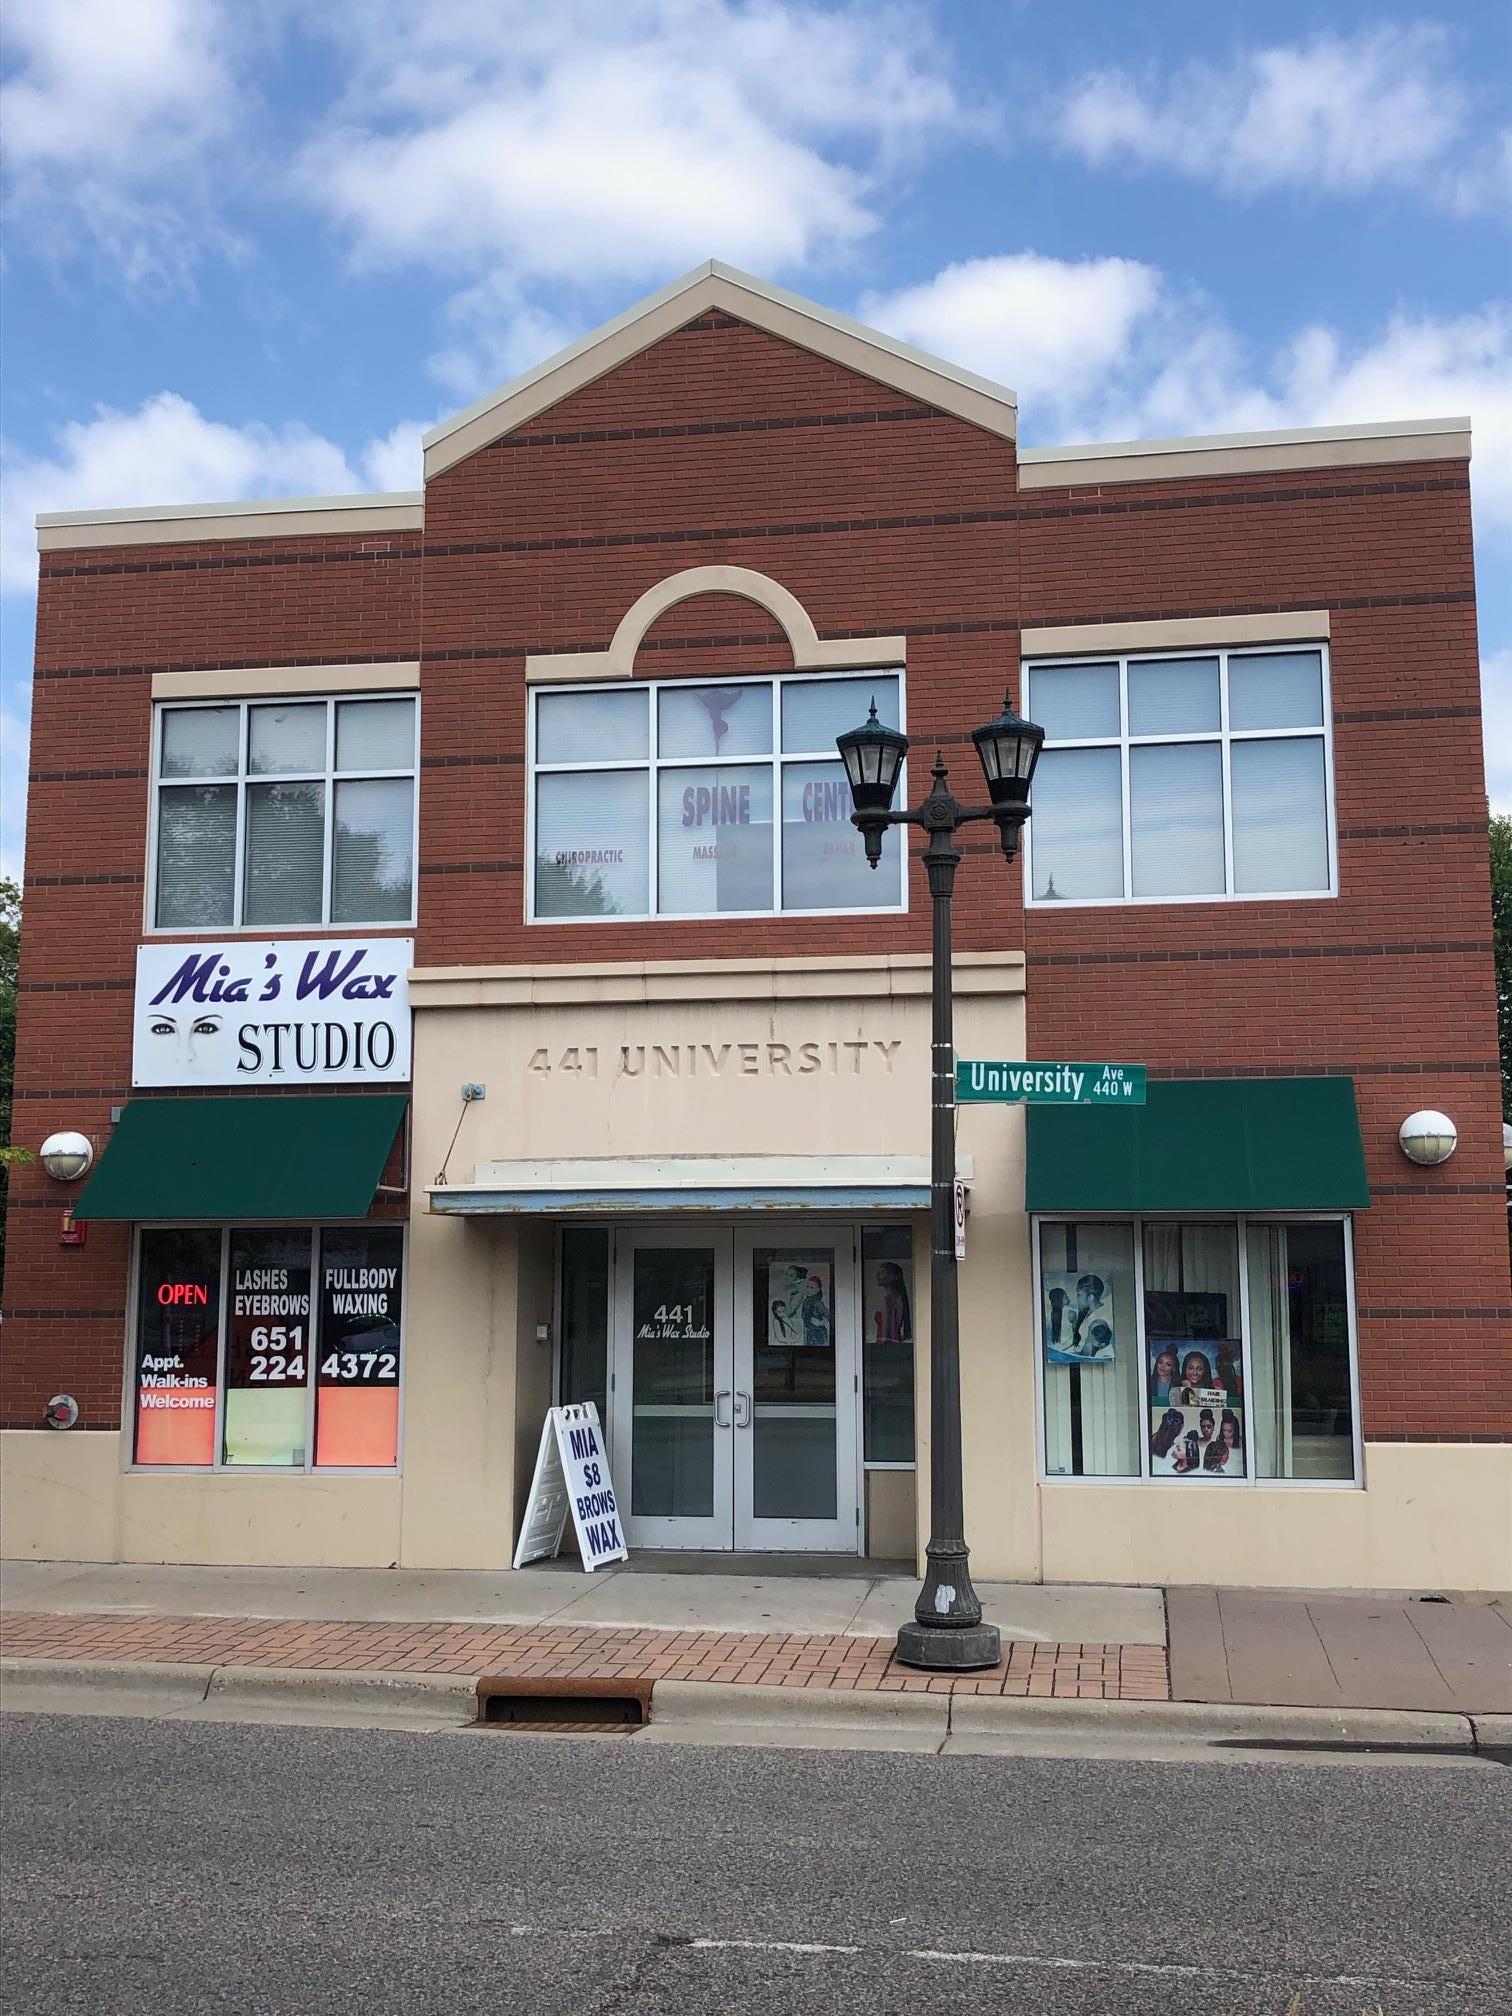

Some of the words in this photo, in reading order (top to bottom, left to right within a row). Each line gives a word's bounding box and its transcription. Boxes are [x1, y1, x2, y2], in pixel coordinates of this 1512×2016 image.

[682, 785, 750, 827] SPINE
[801, 782, 853, 822] CENT
[556, 849, 623, 864] CHIROPRACTIC
[148, 952, 285, 1006] Mia's
[296, 949, 398, 1001] Wax
[236, 1021, 398, 1074] STUDIO
[527, 1046, 599, 1081] 441
[620, 1040, 902, 1079] UNIVERSITY
[971, 1062, 1084, 1101] University
[1102, 1065, 1124, 1080] Ave
[1093, 1081, 1119, 1096] 440
[1122, 1081, 1133, 1096] W
[235, 1268, 288, 1290] LASHES
[325, 1268, 397, 1290] FULLBODY
[157, 1283, 208, 1305] OPEN
[235, 1294, 310, 1316] EYEBROWS
[332, 1293, 388, 1315] WAXING
[654, 1304, 693, 1323] 441
[250, 1326, 303, 1351] 651
[636, 1323, 661, 1338] Mia's
[662, 1323, 680, 1338] Wax
[681, 1323, 711, 1338] Studio
[141, 1354, 184, 1371] Appt.
[250, 1355, 305, 1380] 224
[321, 1353, 397, 1379] 4372
[141, 1373, 208, 1388] Walk-ins
[140, 1393, 215, 1408] Welcome
[569, 1427, 599, 1460] MIA
[583, 1462, 601, 1490] $8
[576, 1489, 616, 1521] BROWS
[585, 1518, 621, 1556] WAX
